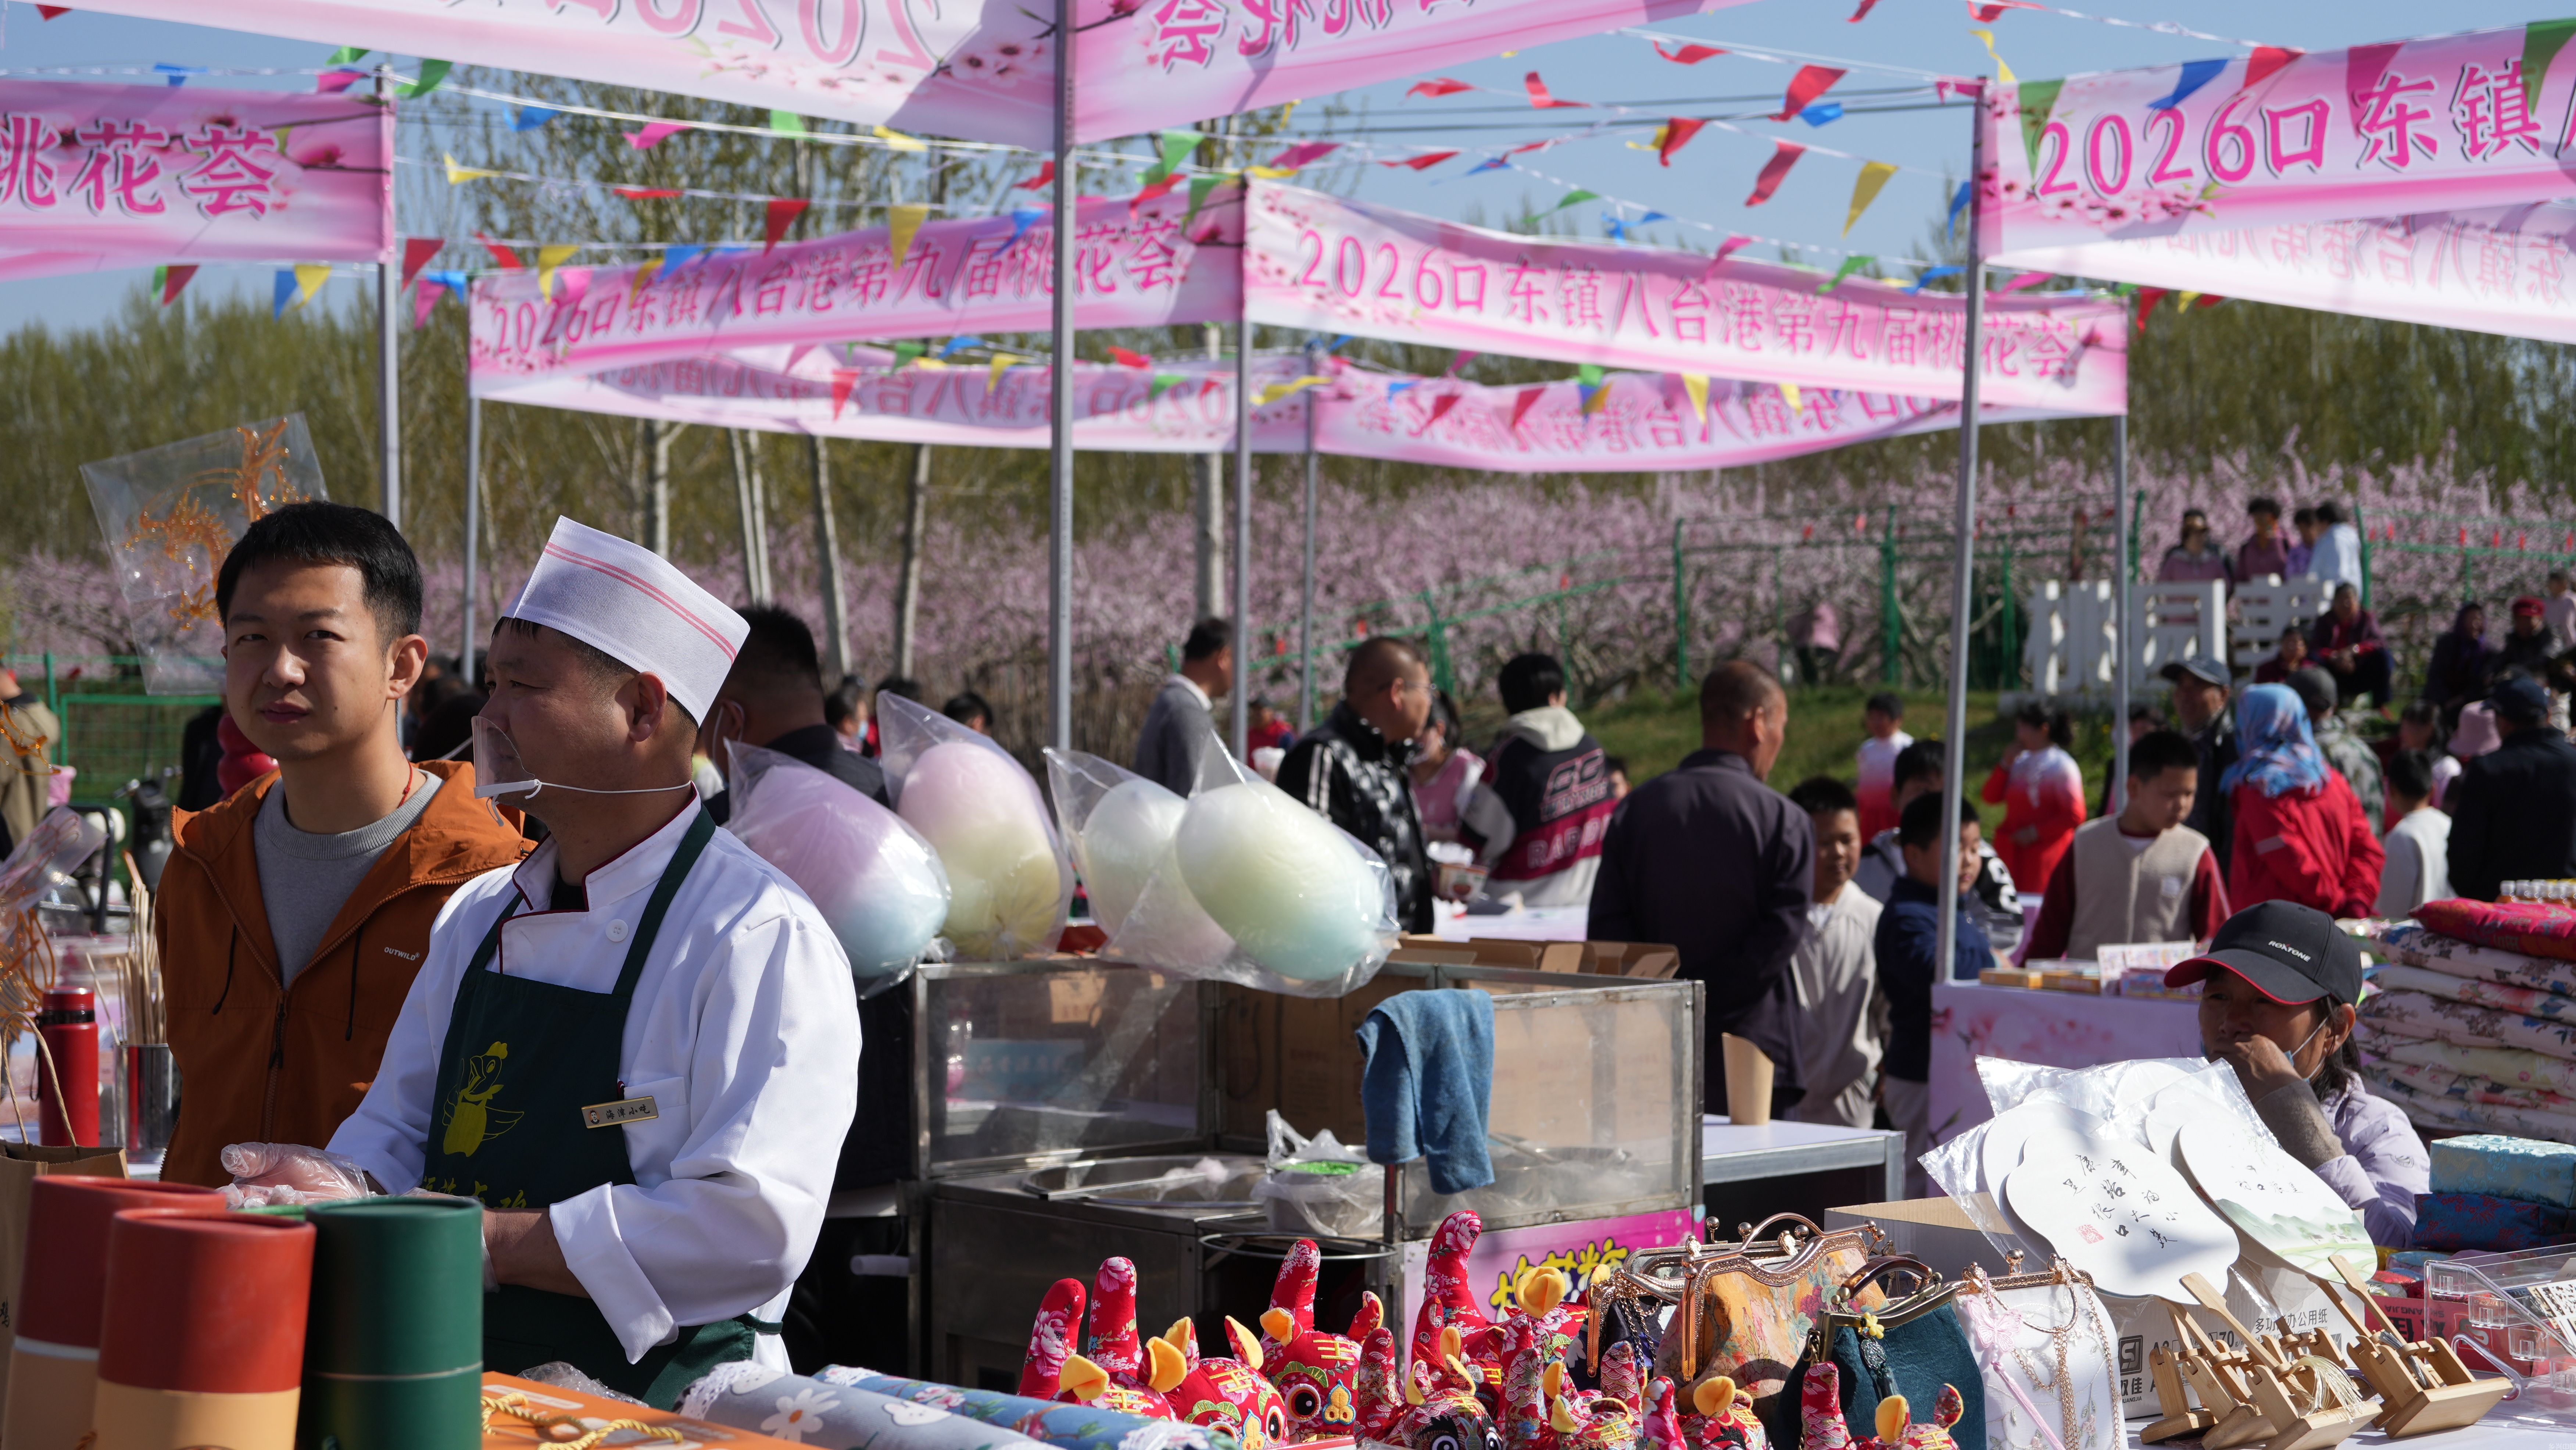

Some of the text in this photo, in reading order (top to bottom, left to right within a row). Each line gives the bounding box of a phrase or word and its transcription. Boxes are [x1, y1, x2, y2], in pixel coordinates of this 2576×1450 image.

[2035, 58, 2576, 201] 2026口东镇
[2268, 940, 2311, 962] ROXTONE
[606, 1104, 650, 1120] 海津小吃
[2255, 1308, 2328, 1334] 多功办公用纸
